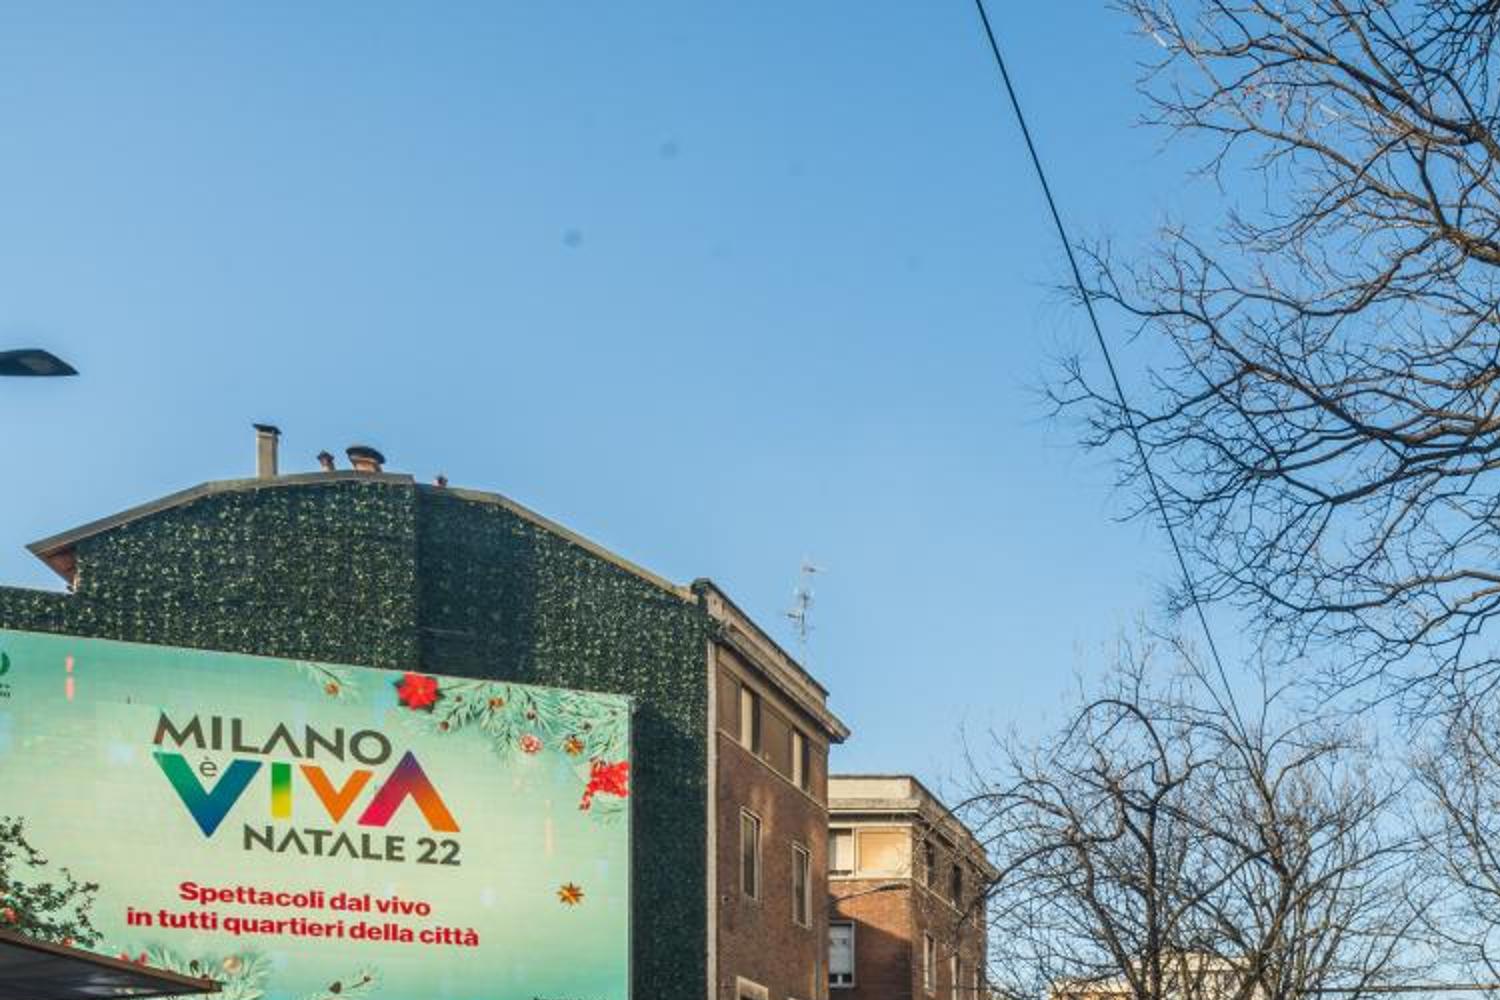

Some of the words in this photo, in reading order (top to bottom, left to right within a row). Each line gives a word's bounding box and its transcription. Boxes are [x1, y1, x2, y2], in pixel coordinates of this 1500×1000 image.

[153, 711, 393, 766] MILANO
[199, 756, 218, 777] è
[152, 749, 461, 839] VIVA
[243, 823, 405, 862] NATALE
[416, 836, 461, 867] 22
[179, 881, 325, 909] Spettacoli
[329, 892, 370, 912] dal
[376, 896, 431, 917] vivo
[127, 906, 153, 926] in
[158, 909, 218, 930] tutti
[223, 917, 344, 938] quartieri
[349, 921, 414, 943] della
[419, 925, 479, 947] città
